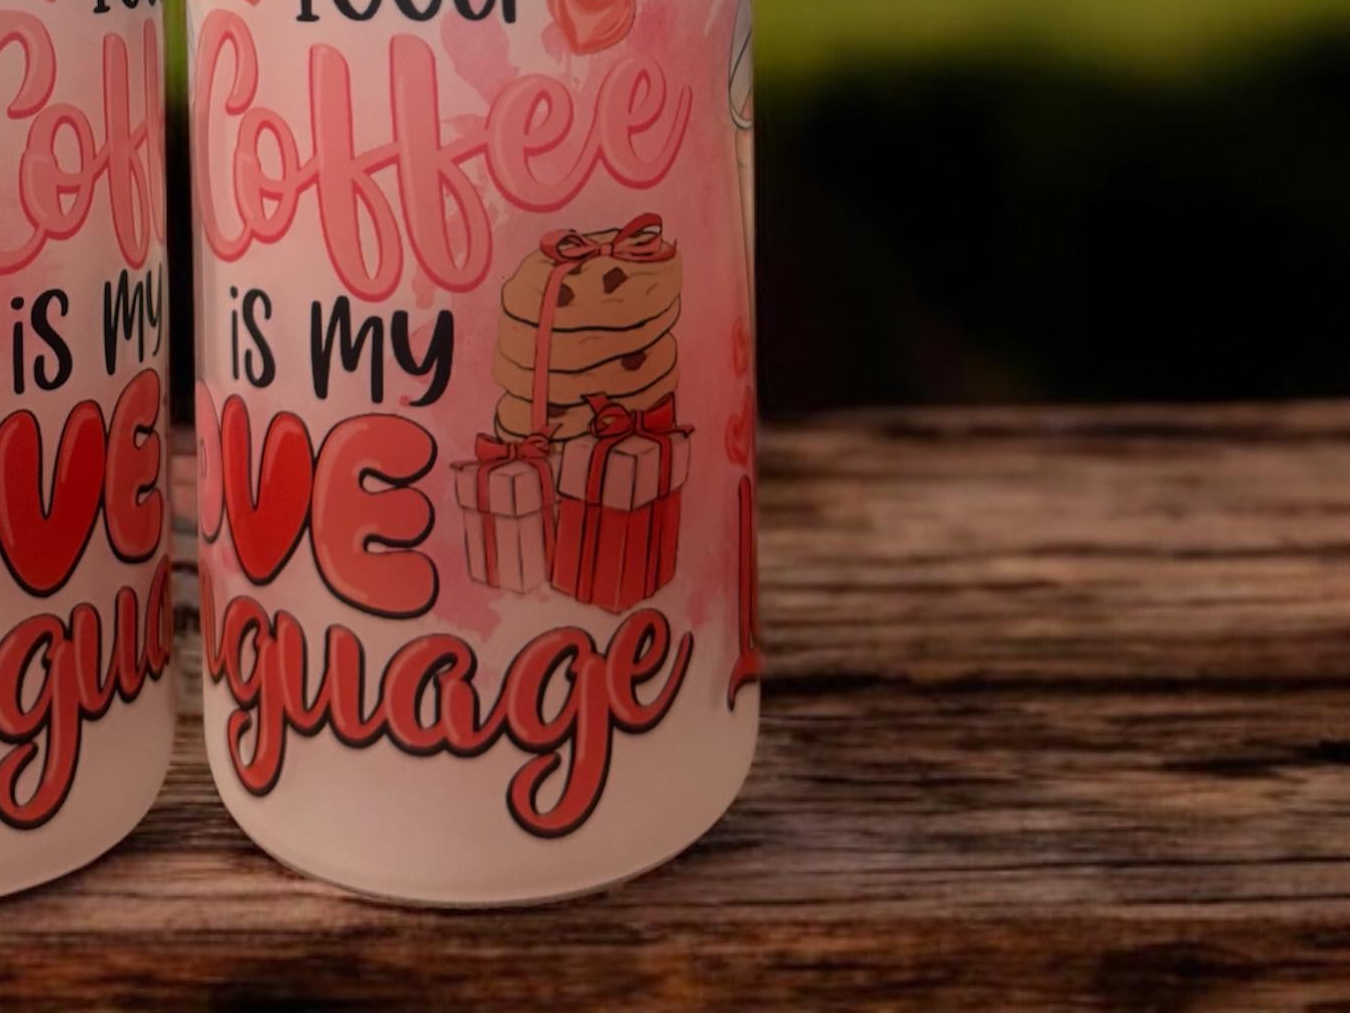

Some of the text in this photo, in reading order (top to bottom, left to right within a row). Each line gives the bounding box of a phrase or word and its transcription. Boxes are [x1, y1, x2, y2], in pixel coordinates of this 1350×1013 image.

[195, 9, 693, 302] Coffee
[11, 263, 162, 394] is my
[230, 285, 455, 407] is my
